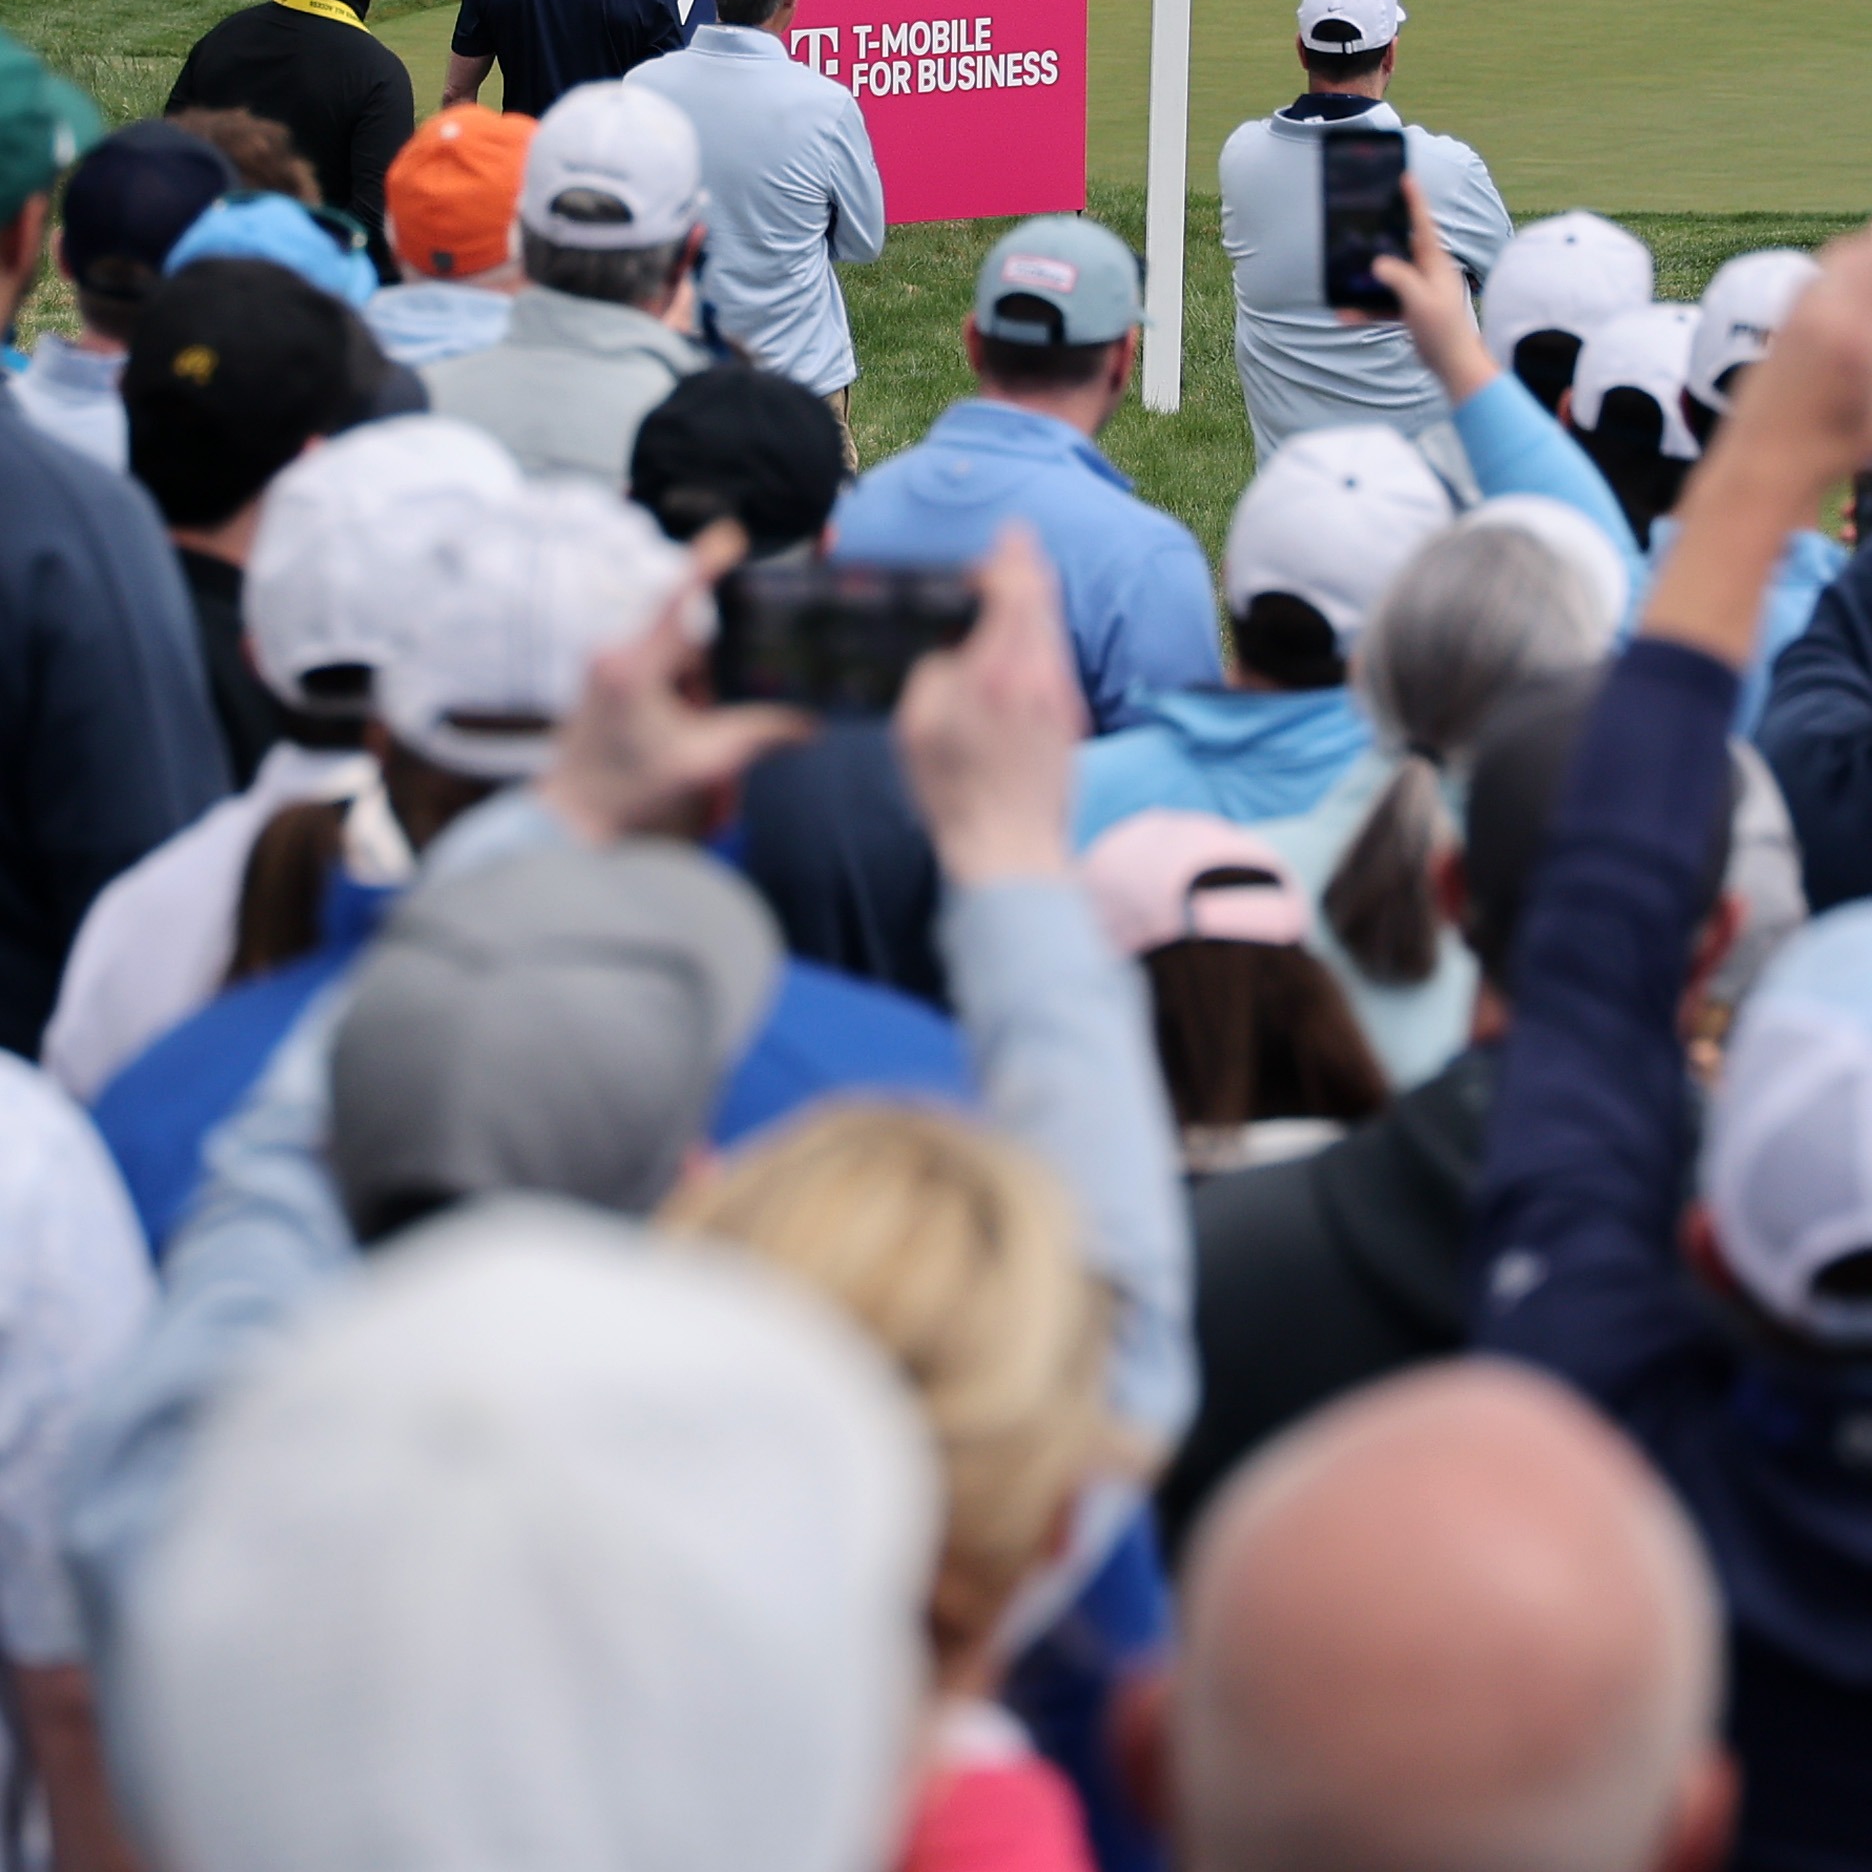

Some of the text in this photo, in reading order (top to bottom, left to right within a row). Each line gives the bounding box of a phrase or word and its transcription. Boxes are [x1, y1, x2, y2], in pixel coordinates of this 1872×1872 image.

[853, 17, 992, 59] T-MOBILE
[852, 49, 1059, 98] FOR BUSINESS
